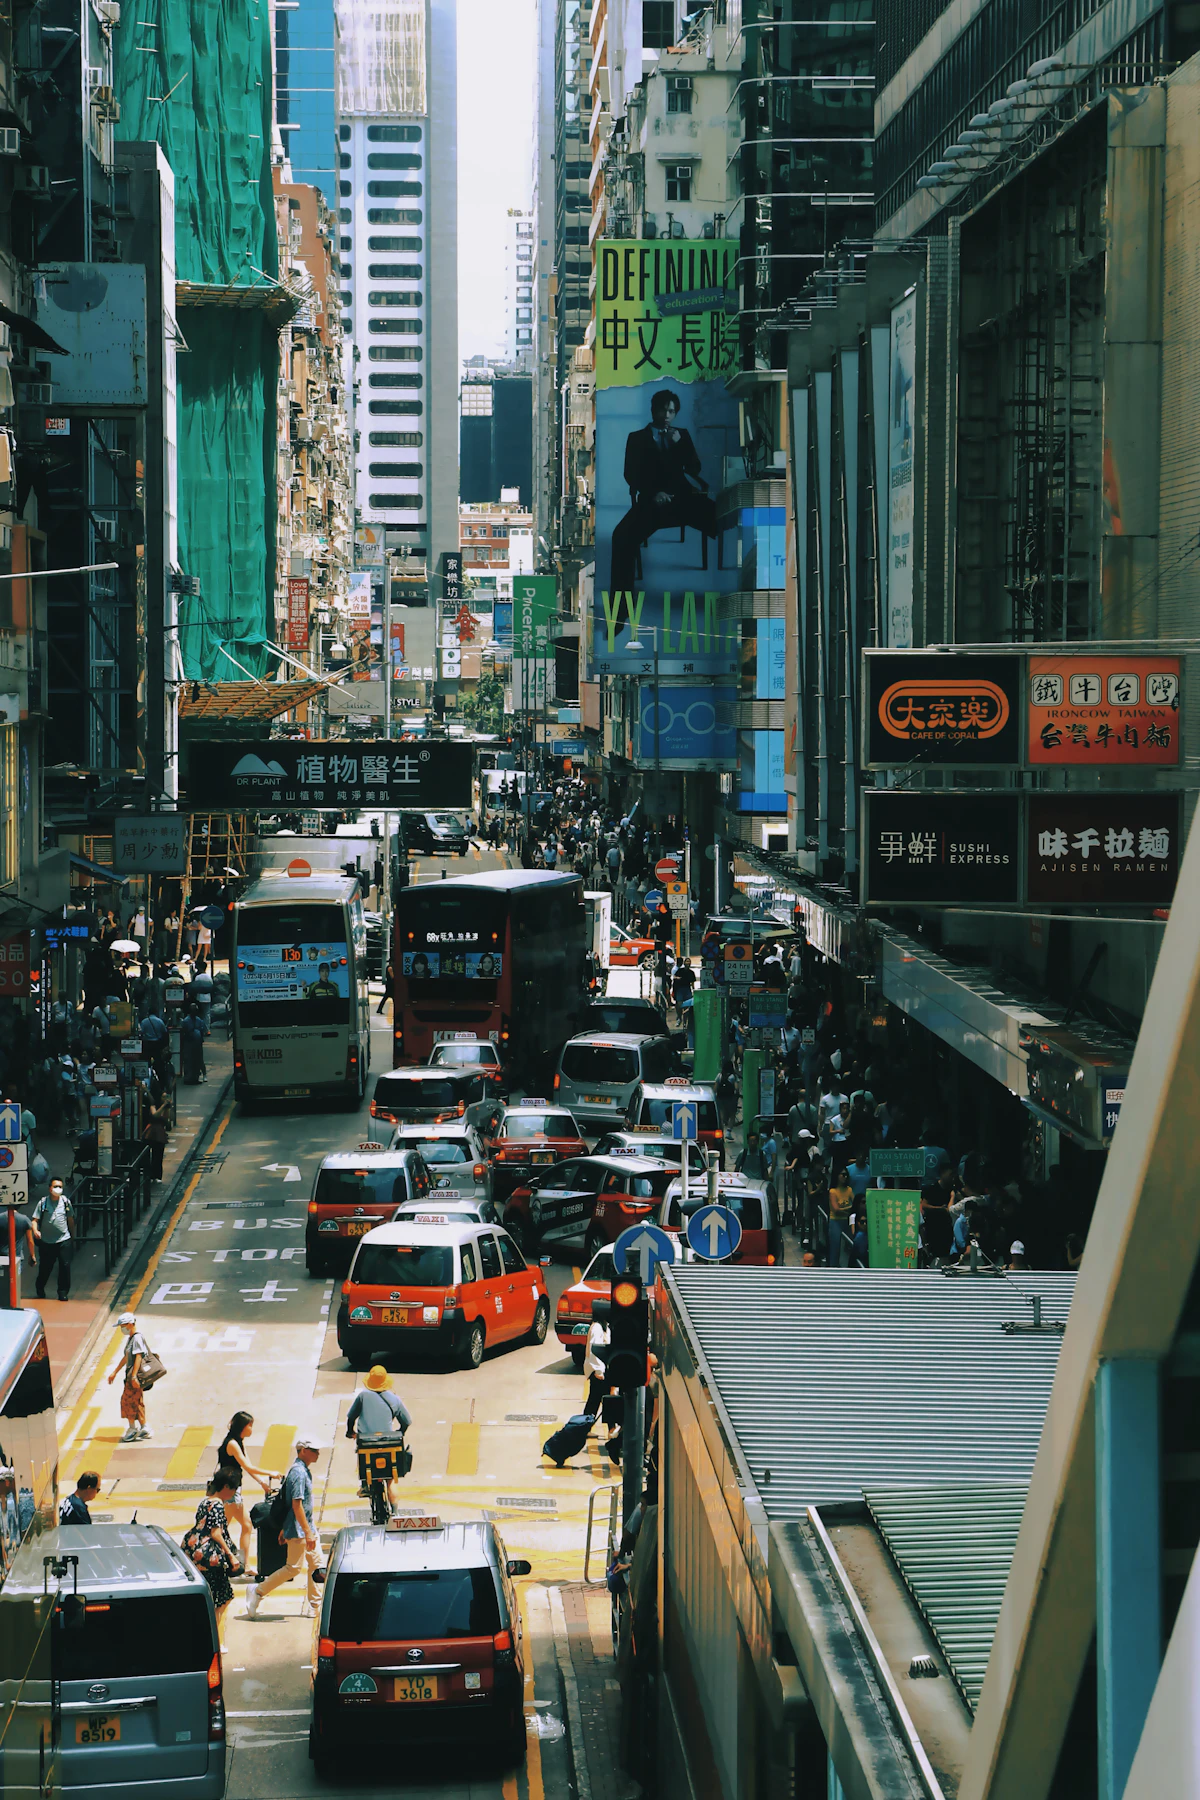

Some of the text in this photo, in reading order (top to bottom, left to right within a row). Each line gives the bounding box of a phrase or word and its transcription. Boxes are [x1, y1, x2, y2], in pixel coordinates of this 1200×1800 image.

[665, 294, 718, 309] education
[396, 698, 420, 706] STYLE
[1047, 709, 1166, 718] IRONCOW TAIWAN
[911, 732, 934, 740] CAFE
[948, 732, 977, 740] CORAL
[271, 790, 390, 801] 高山植物 純淨美肌
[949, 843, 991, 852] SUSHI
[949, 854, 1010, 864] EXPRESS
[1039, 863, 1169, 872] AJISEN RAMEN
[730, 970, 747, 979] 全日
[257, 1048, 283, 1060] KMB
[1107, 1091, 1124, 1101] 旺角
[882, 1163, 913, 1172] 的士站
[11, 1173, 19, 1184] 7
[12, 1191, 25, 1202] 12
[416, 1215, 445, 1223] TAXI
[187, 1218, 305, 1232] BUS
[160, 1247, 307, 1263] STOP
[149, 1280, 299, 1305] 巴士
[392, 1516, 437, 1529] TAXI
[354, 1679, 362, 1687] 4
[406, 1676, 425, 1689] YD
[399, 1688, 433, 1701] 3618
[88, 1716, 108, 1730] WP
[81, 1728, 116, 1743] 8519
